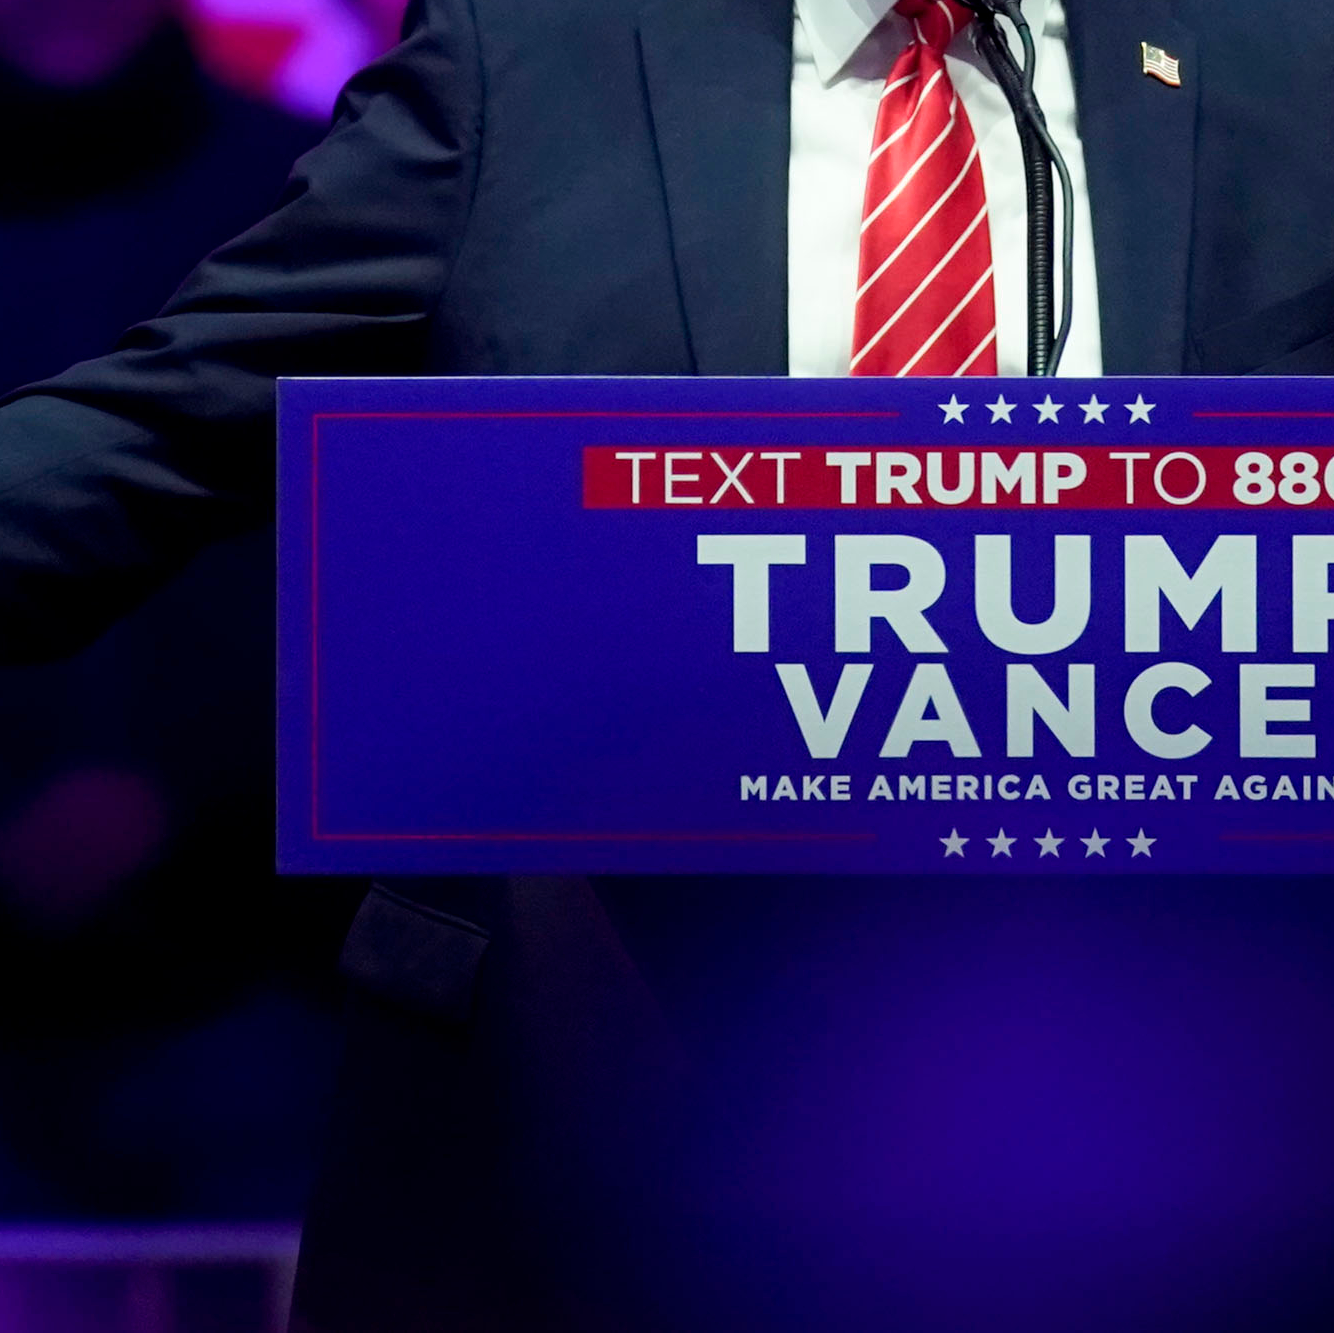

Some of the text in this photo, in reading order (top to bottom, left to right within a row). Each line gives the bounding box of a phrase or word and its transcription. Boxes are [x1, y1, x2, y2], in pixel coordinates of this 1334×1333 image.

[615, 450, 803, 505] TEXT
[825, 450, 1089, 506] TRUMP
[1108, 450, 1208, 507] TO
[774, 660, 1318, 761] VANCE
[739, 773, 852, 802] MAKE
[866, 773, 1052, 802] AMERICA
[1066, 773, 1199, 802] GREAT
